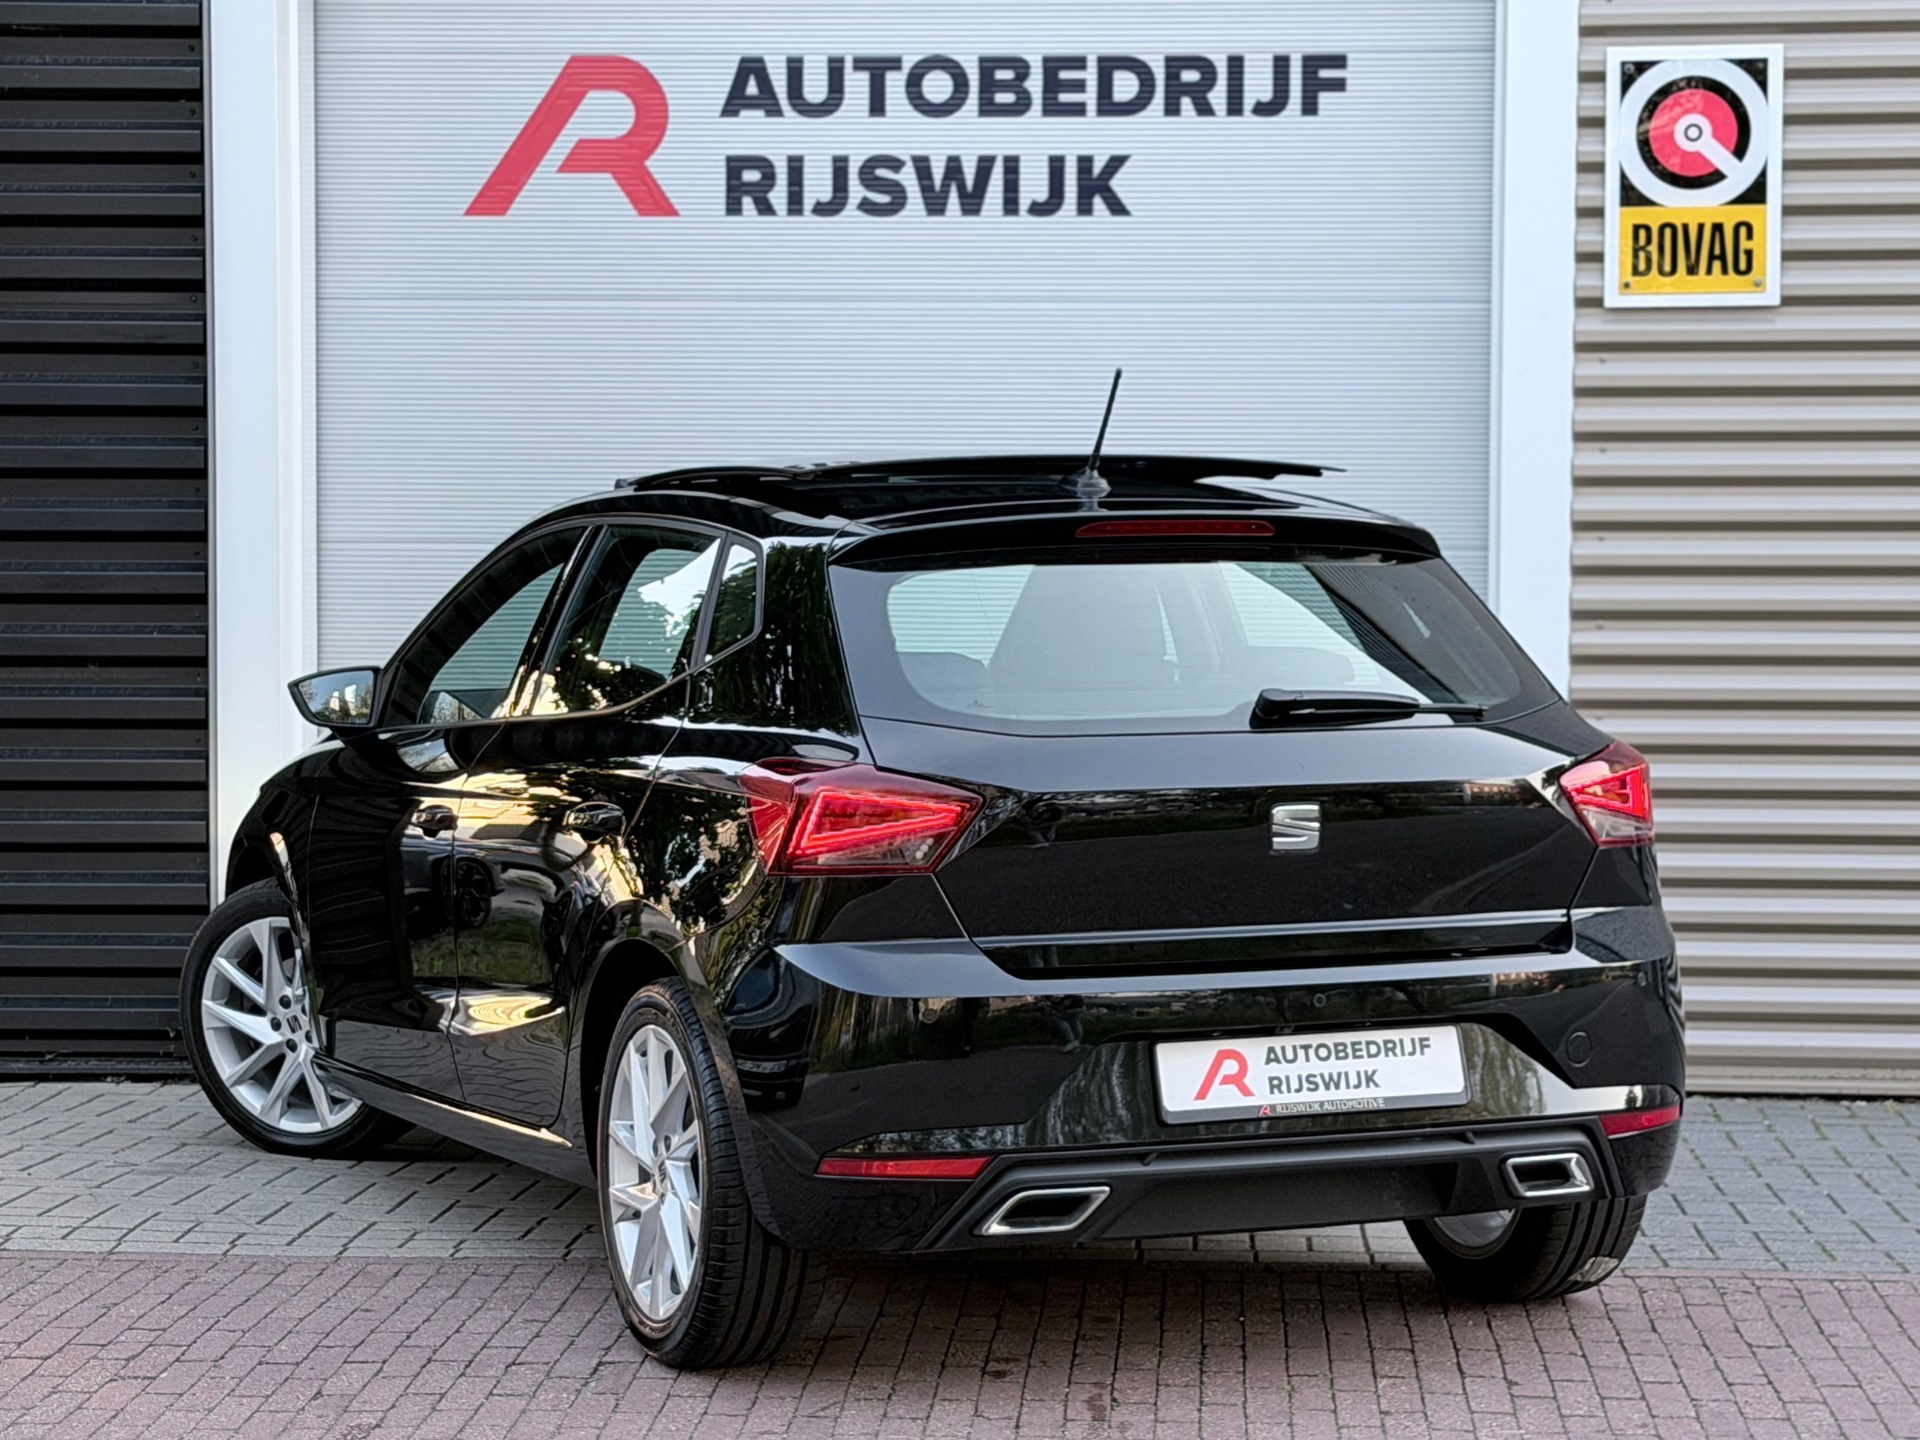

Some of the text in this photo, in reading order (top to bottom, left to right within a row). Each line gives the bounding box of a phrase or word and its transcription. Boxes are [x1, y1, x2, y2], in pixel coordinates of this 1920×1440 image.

[721, 54, 1347, 118] AUTOBEDRIJF
[725, 154, 1131, 217] RIJSWIJK
[1631, 221, 1754, 277] BOVAG
[1264, 1036, 1431, 1066] AUTOBEDRIJF
[1268, 1069, 1381, 1095] RIJSWIJK
[1276, 1097, 1386, 1115] RIJSWIJK AUTOMOTIVE
